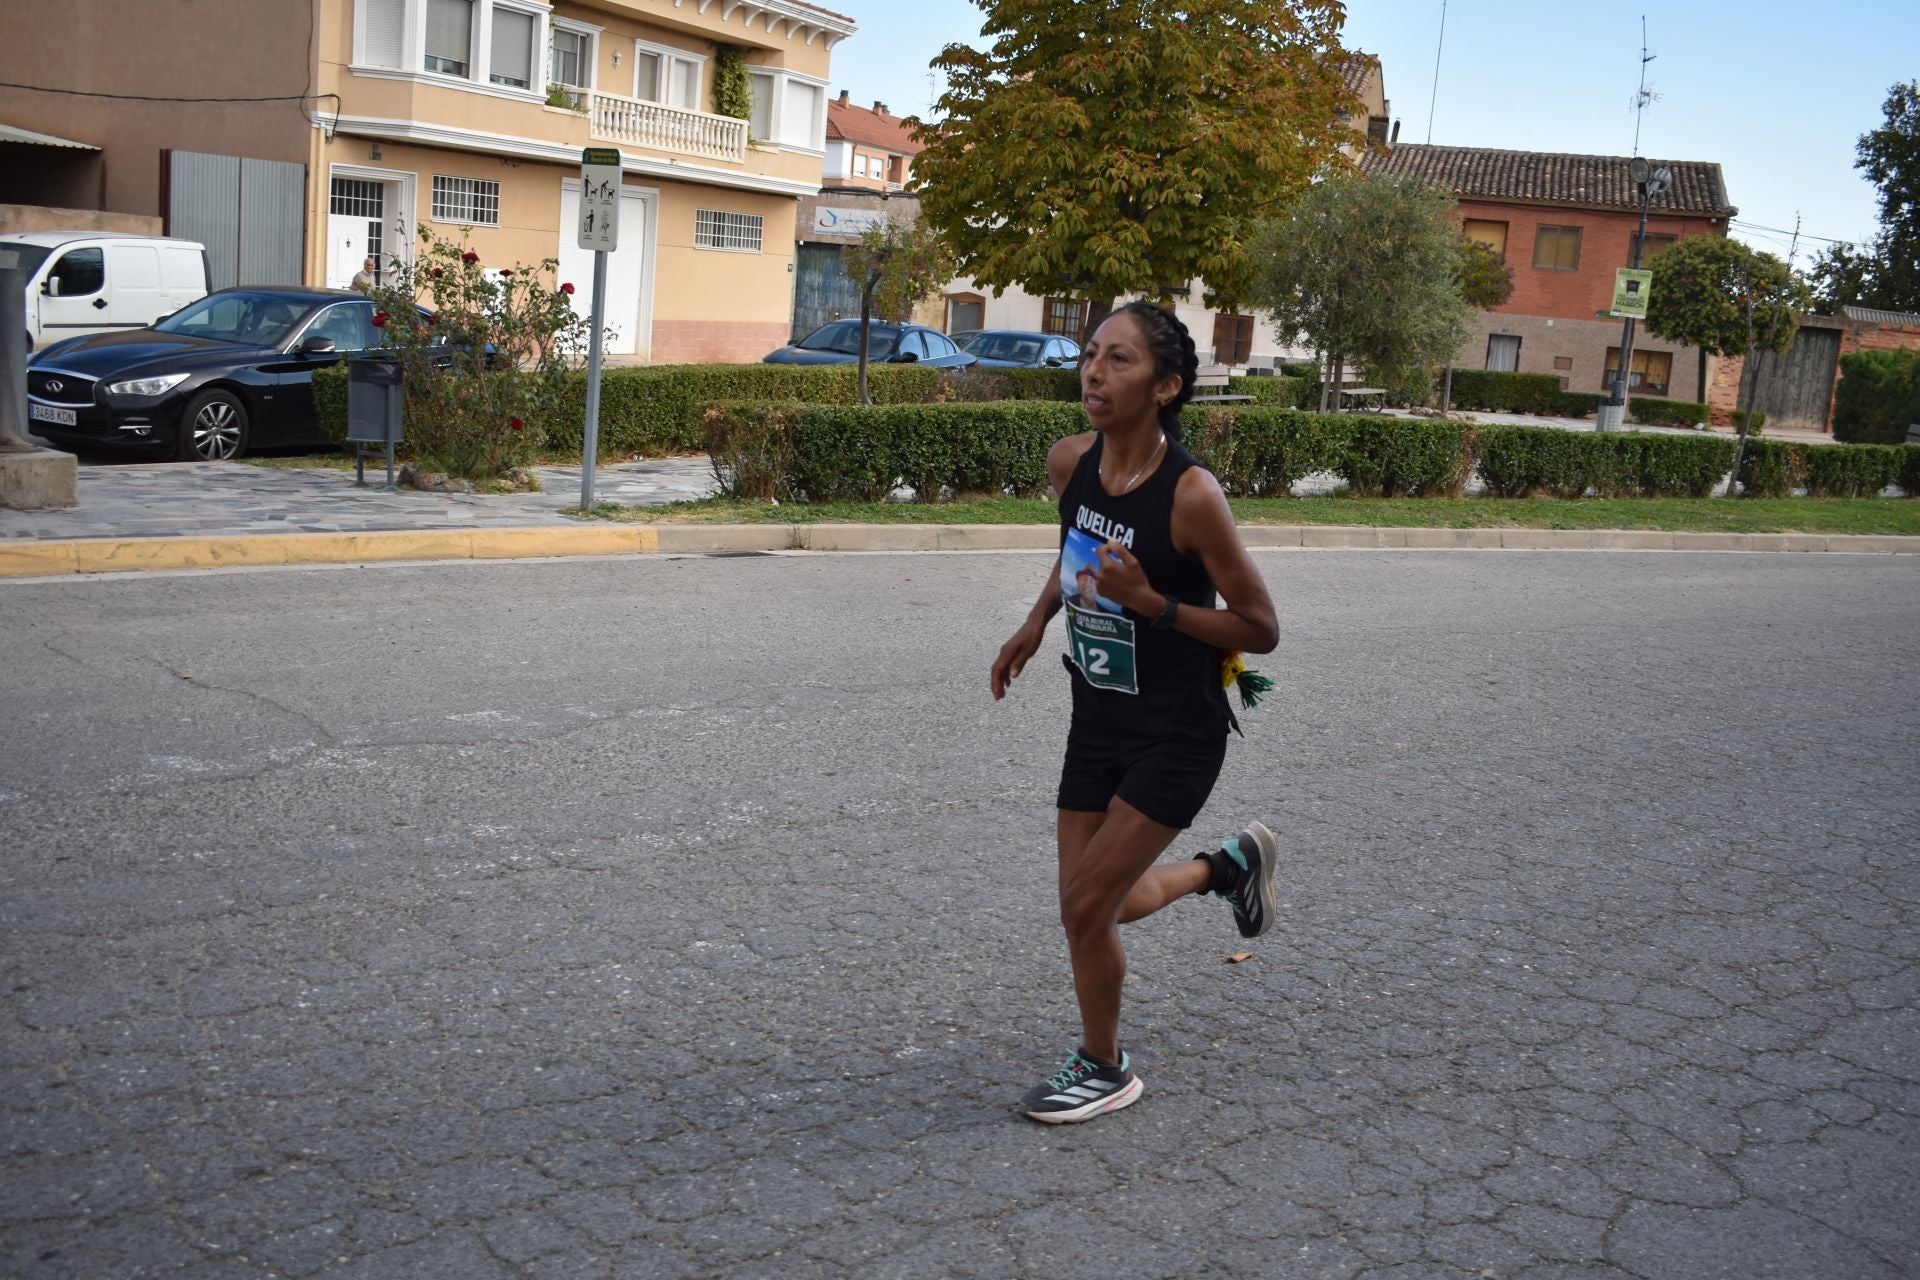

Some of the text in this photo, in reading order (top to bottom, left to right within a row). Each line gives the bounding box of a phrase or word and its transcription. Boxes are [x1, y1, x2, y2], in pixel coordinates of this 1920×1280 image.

[35, 407, 74, 424] 3468 KDN
[1076, 504, 1134, 549] QUELLCA
[1078, 641, 1110, 675] 12
